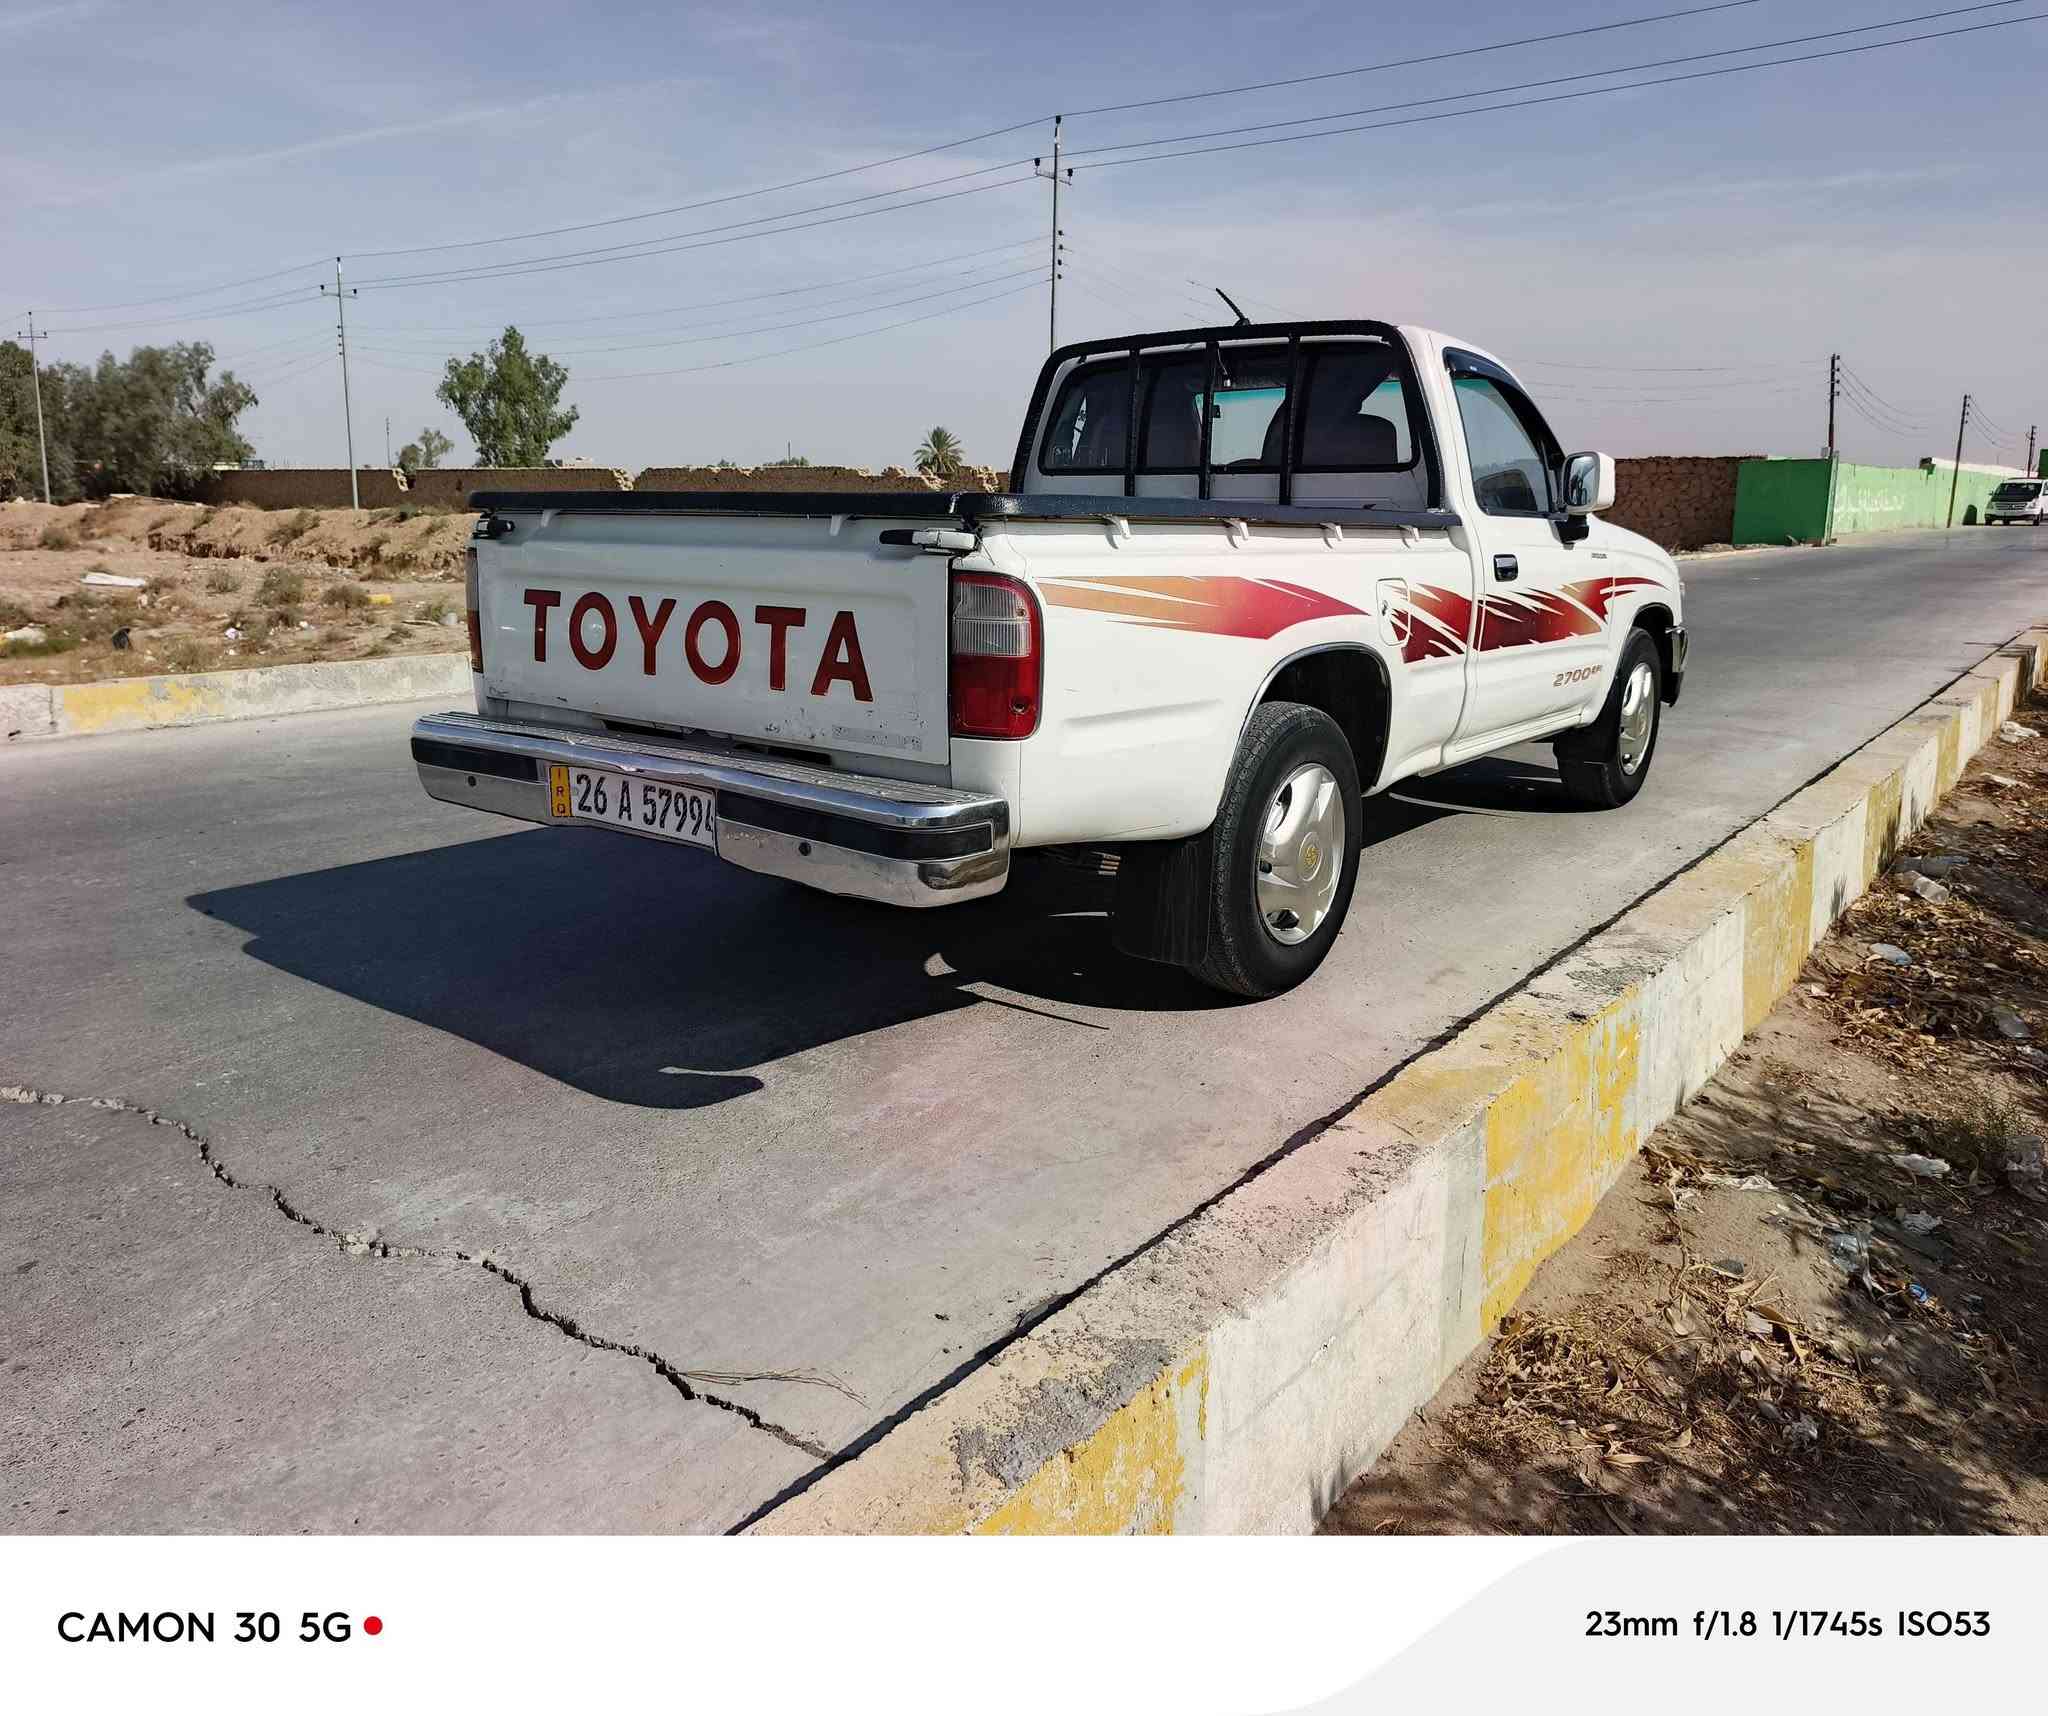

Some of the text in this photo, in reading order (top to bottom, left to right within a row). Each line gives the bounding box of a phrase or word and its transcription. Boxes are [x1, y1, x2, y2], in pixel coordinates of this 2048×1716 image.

[523, 589, 873, 702] TOYOTA
[576, 774, 607, 815] 26
[618, 780, 632, 821] A
